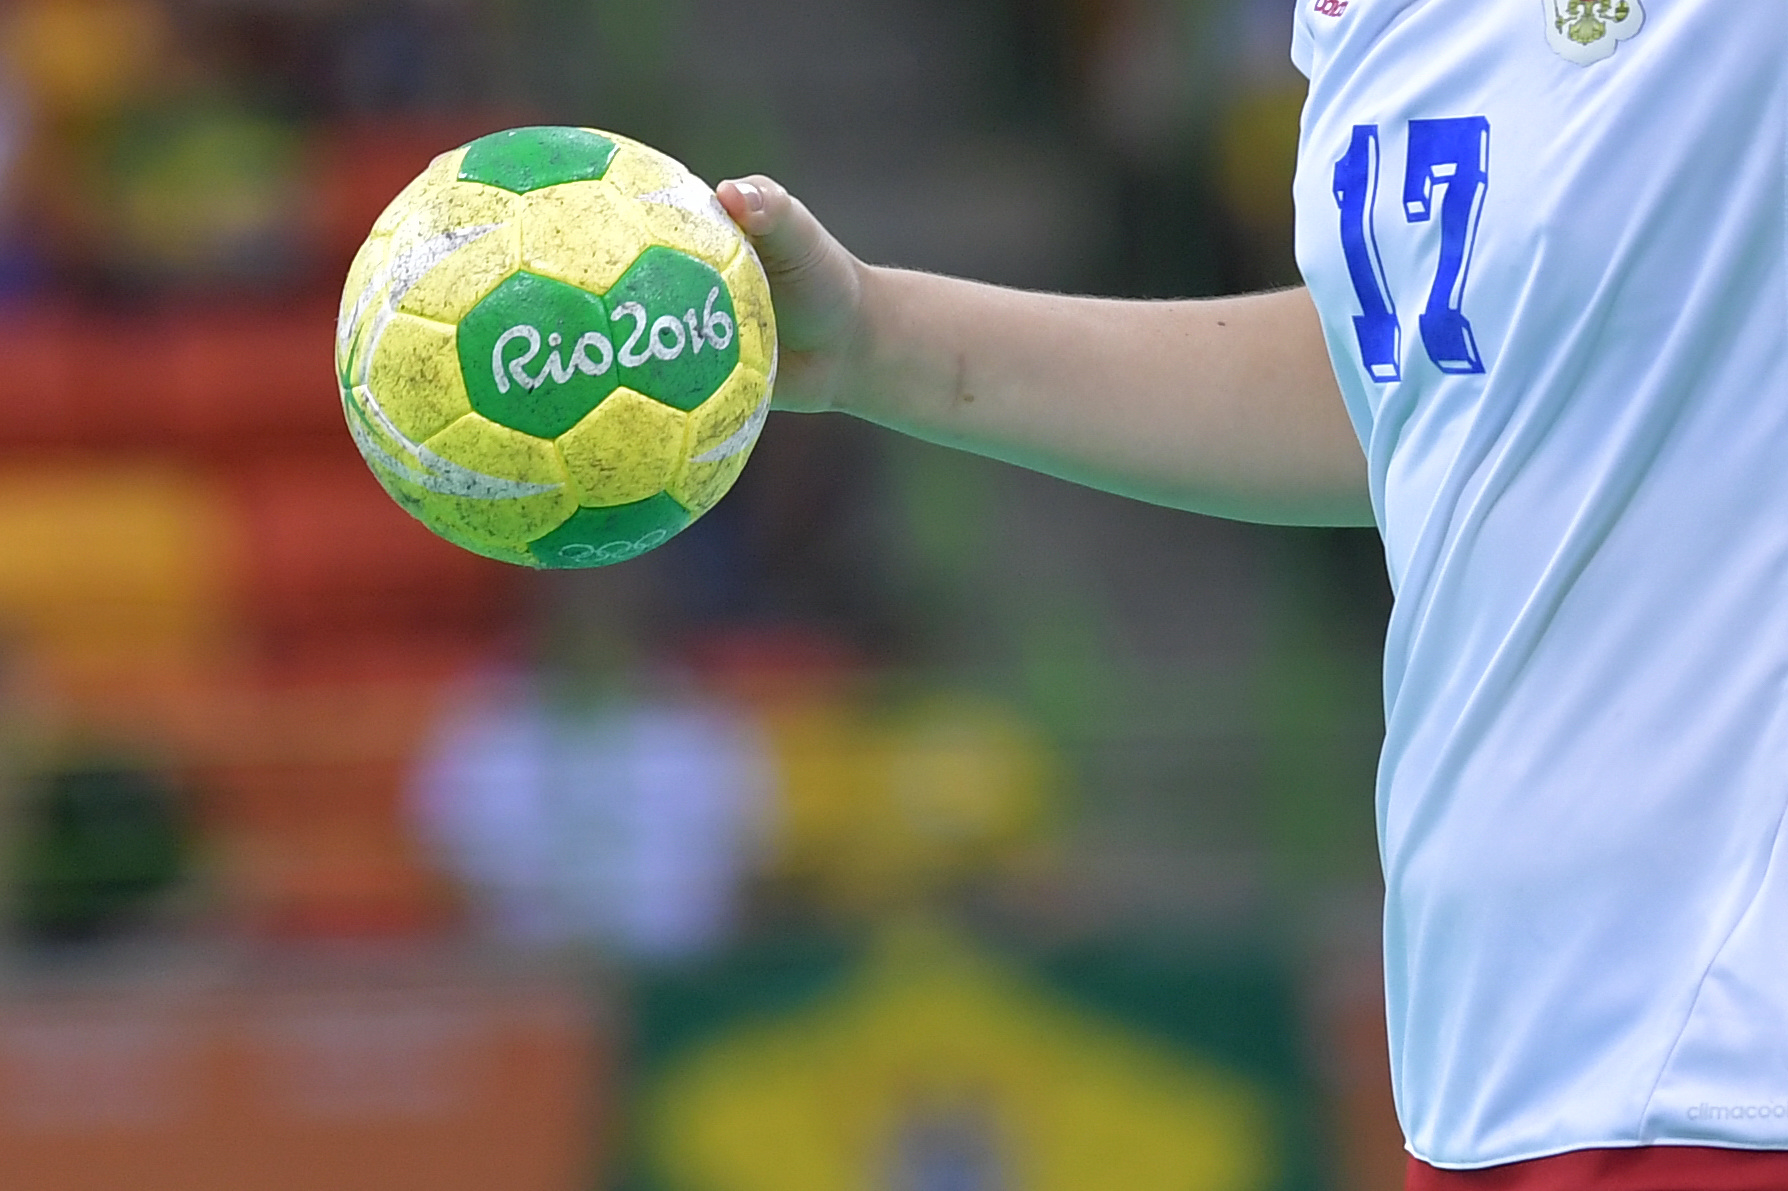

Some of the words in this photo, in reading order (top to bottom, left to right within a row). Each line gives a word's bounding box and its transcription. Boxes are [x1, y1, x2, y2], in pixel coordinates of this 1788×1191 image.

[492, 325, 613, 394] Rio
[610, 286, 733, 367] 2016
[1332, 115, 1490, 384] 17
